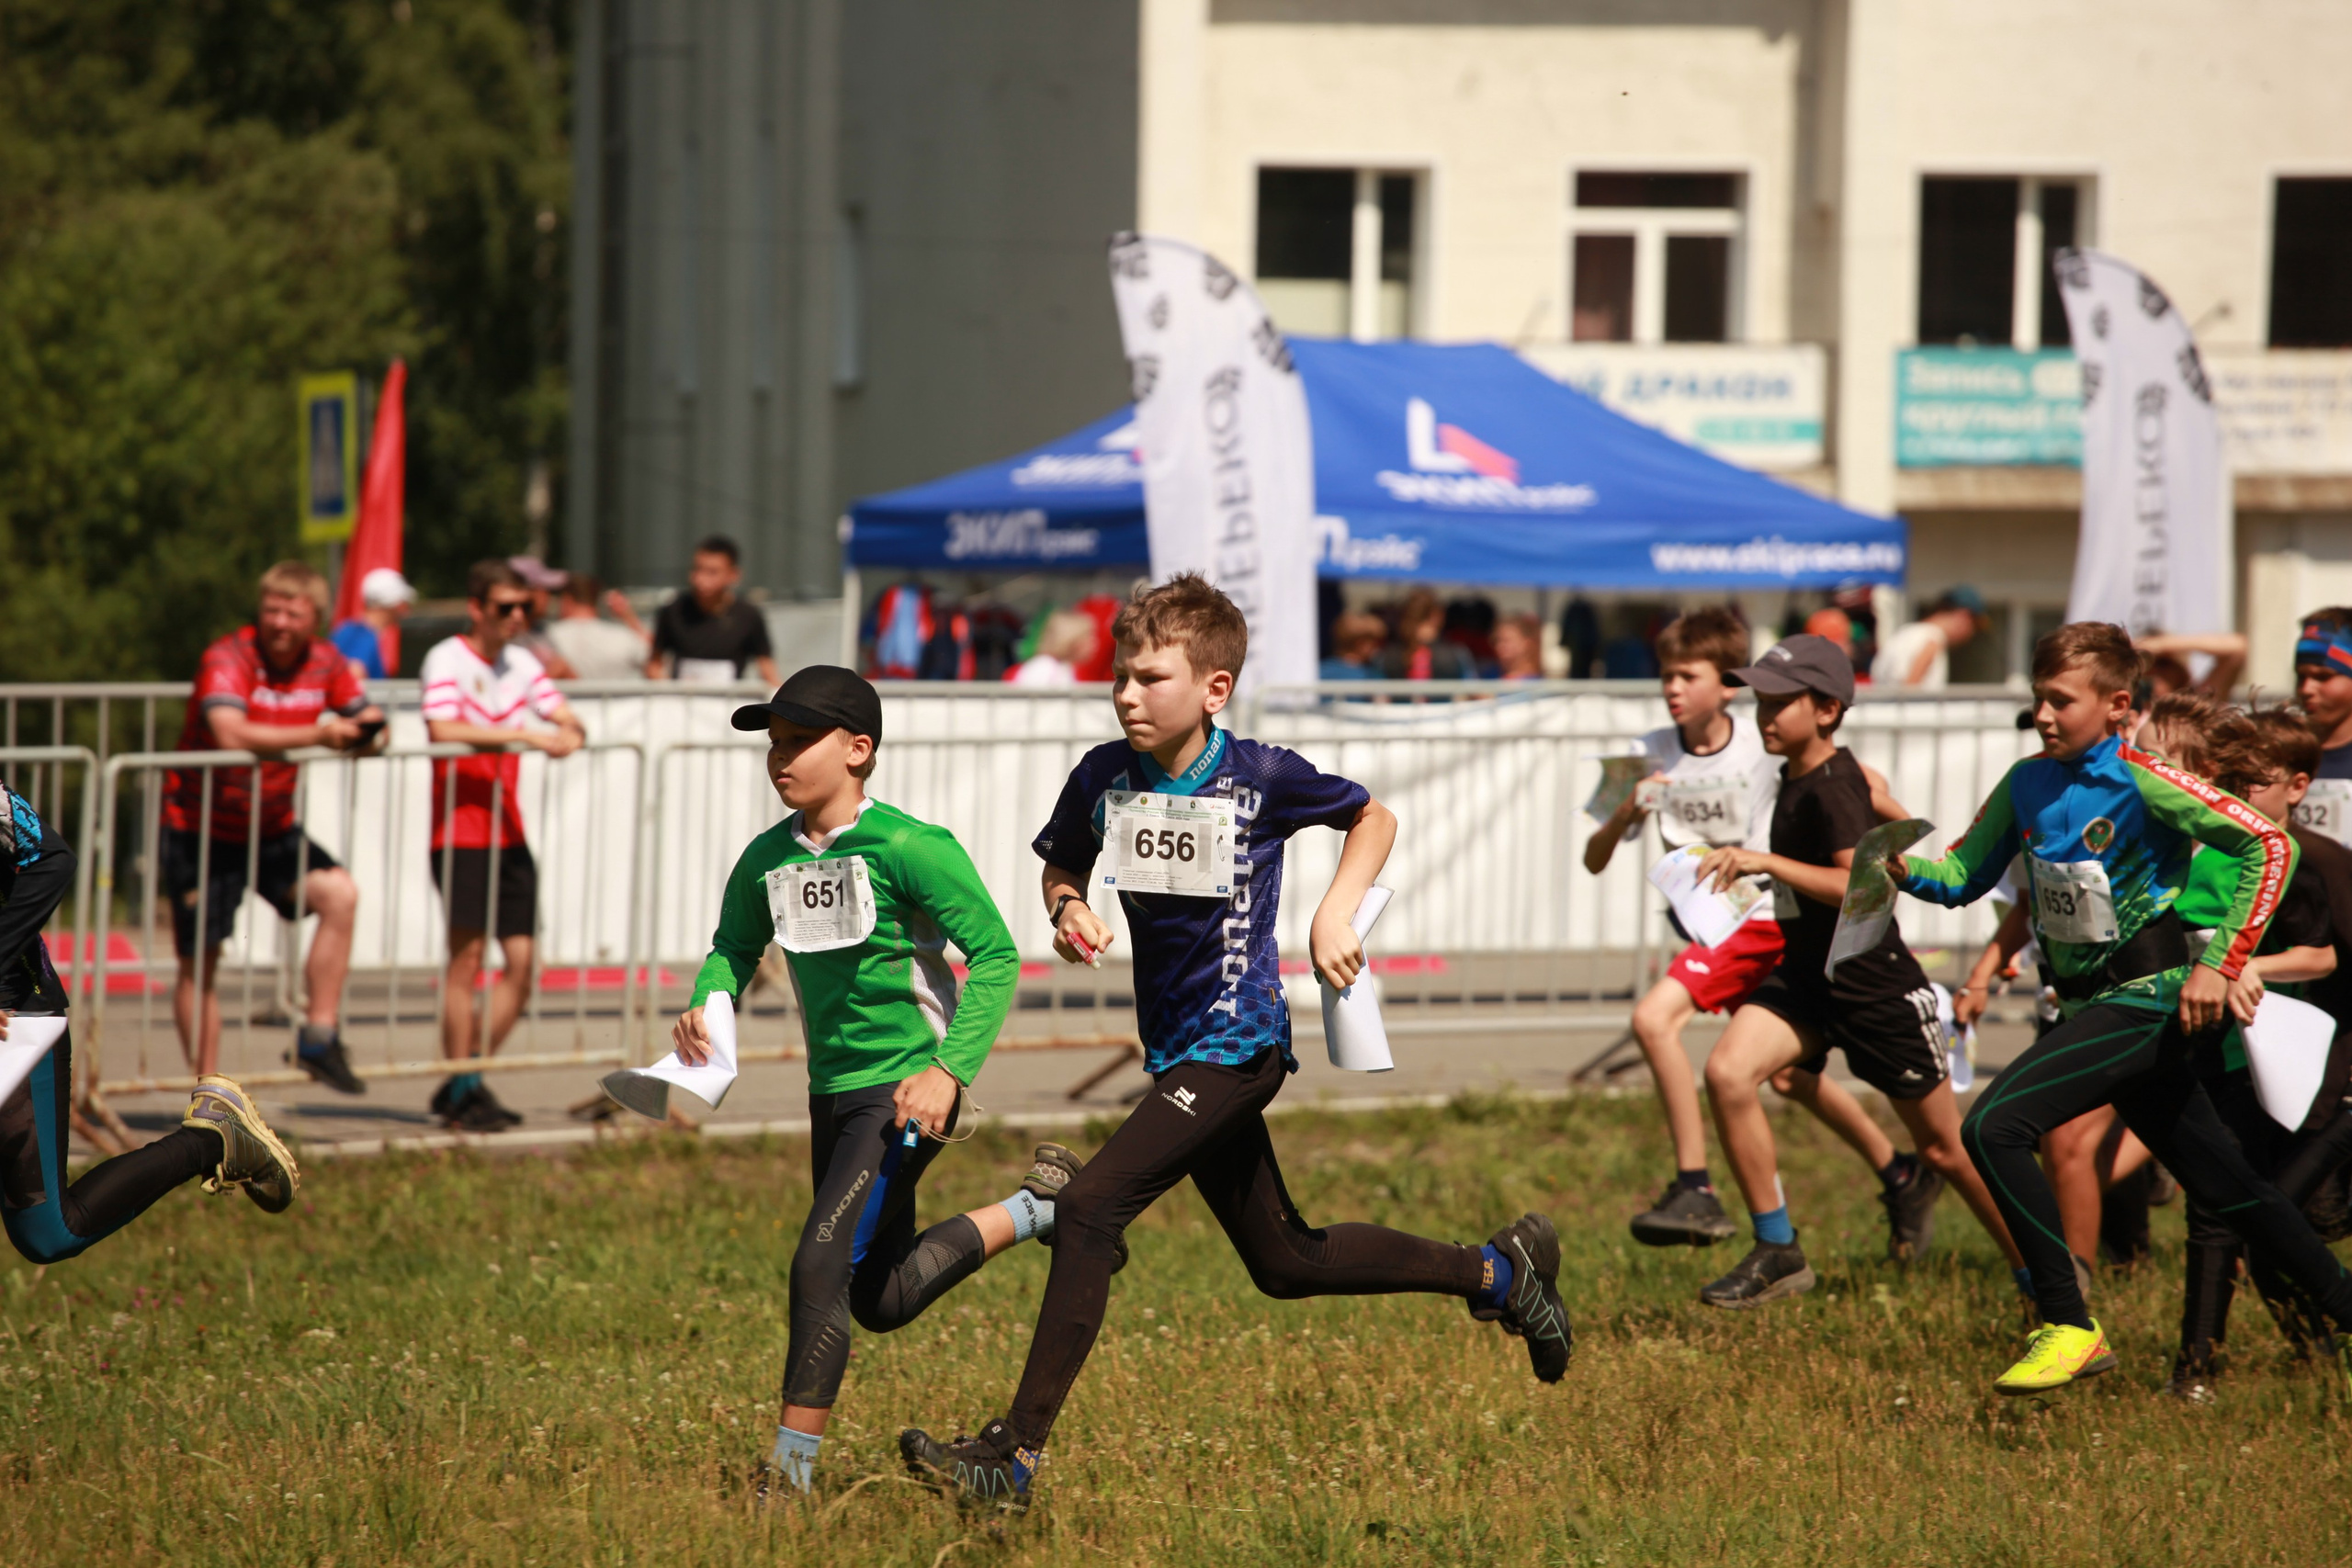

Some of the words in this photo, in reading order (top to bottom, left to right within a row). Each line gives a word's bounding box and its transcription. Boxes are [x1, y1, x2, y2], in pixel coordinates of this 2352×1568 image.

[1683, 800, 1724, 823] 634
[1135, 828, 1195, 863] 656
[802, 878, 843, 909] 651
[2043, 886, 2076, 916] 653
[1160, 1092, 1196, 1117] NORDSKI
[830, 1169, 869, 1224] NORD
